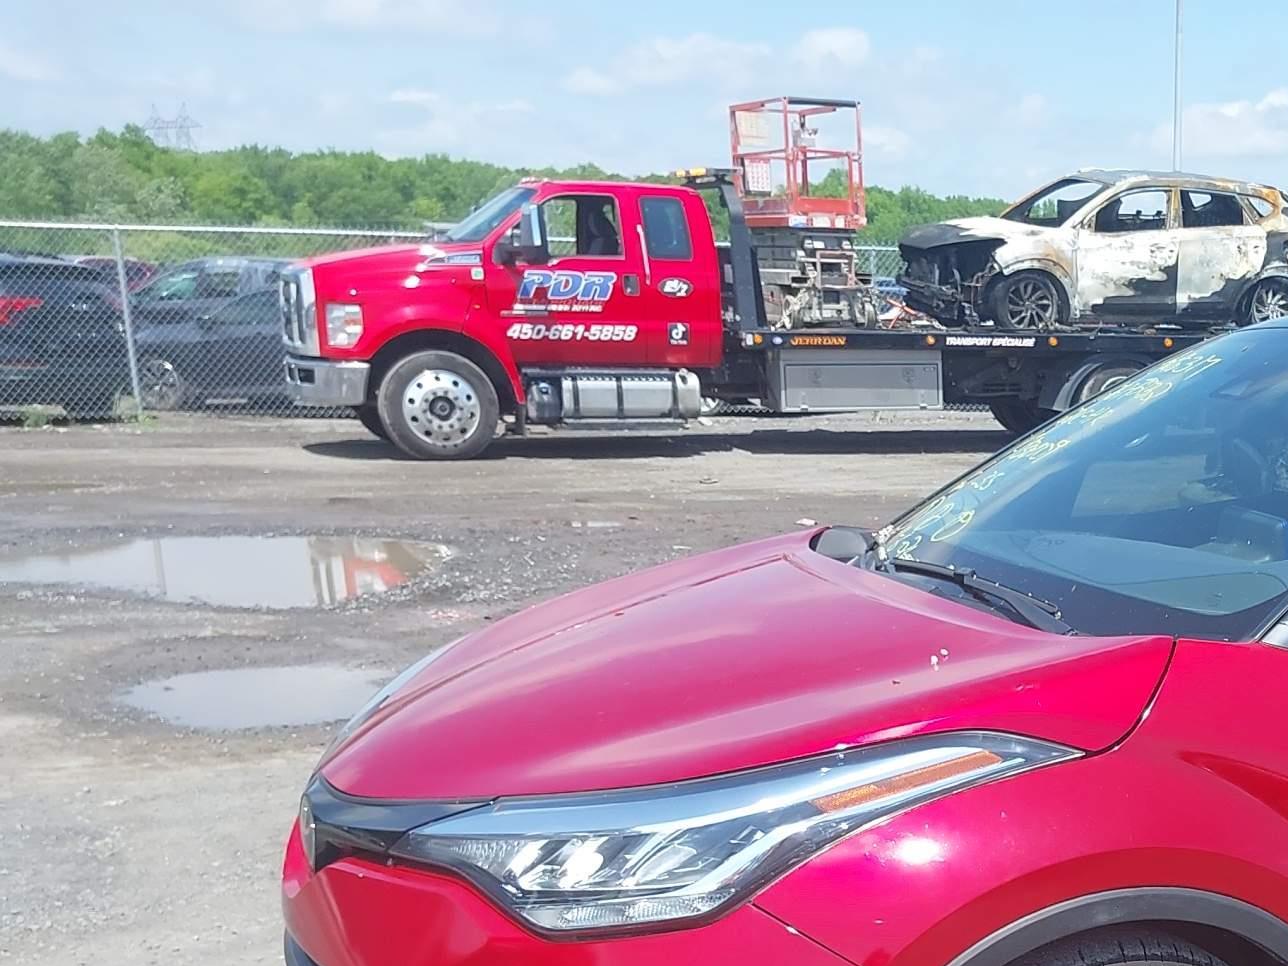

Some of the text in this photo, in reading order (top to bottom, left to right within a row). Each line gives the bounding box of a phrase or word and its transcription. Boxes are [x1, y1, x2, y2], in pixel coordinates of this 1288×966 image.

[517, 269, 618, 301] PDR
[506, 322, 638, 342] 450-661-5858
[945, 336, 992, 347] TRANSPORT
